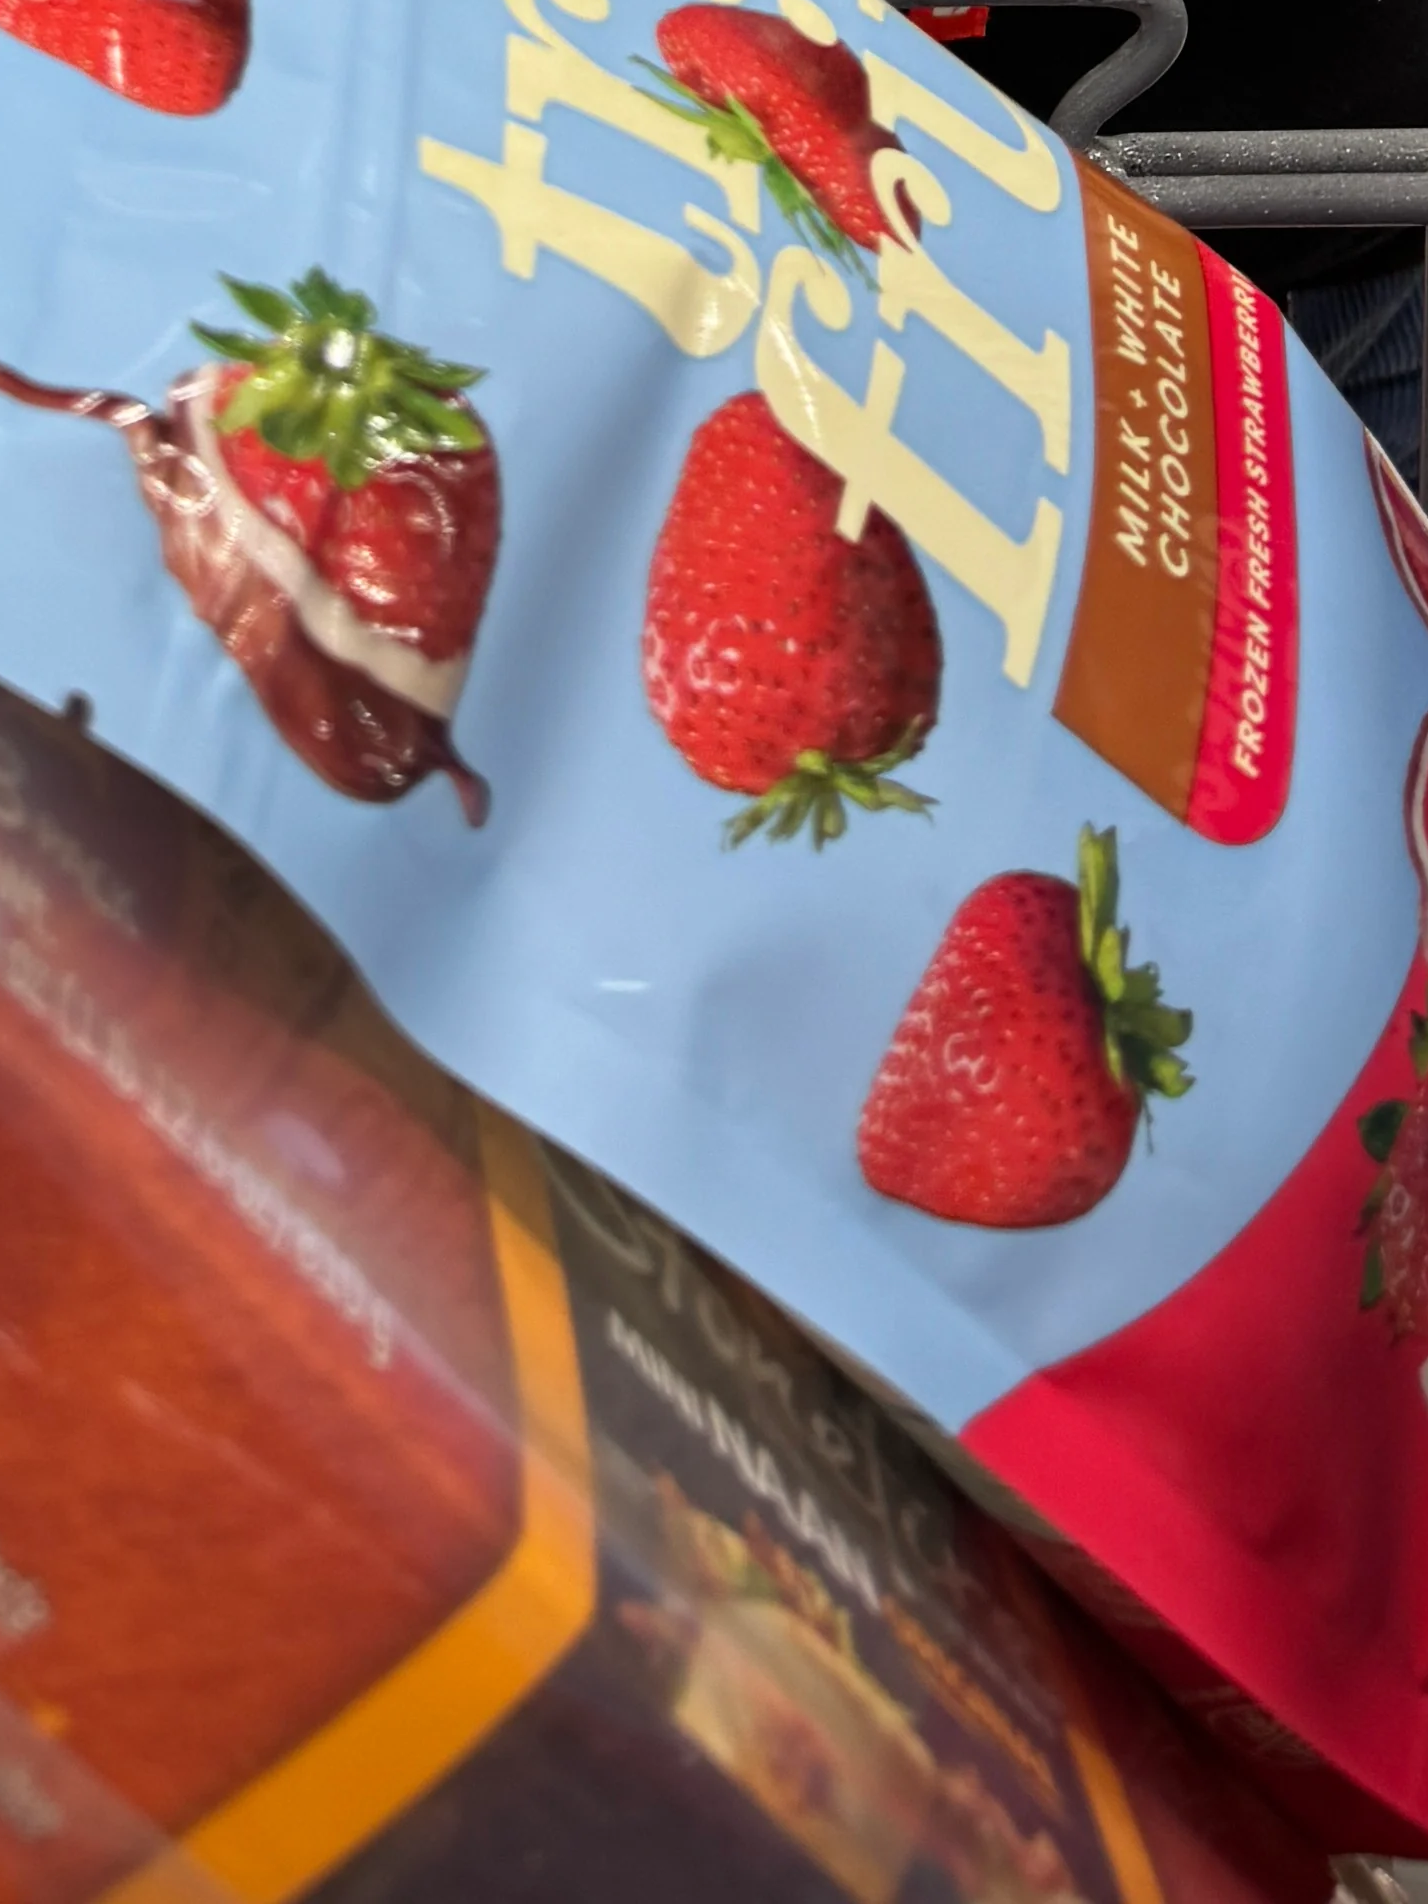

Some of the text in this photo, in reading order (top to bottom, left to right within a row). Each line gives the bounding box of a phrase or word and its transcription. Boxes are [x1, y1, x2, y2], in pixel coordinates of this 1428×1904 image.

[1107, 212, 1149, 367] WHITE
[1114, 416, 1152, 568] MILK
[1150, 259, 1191, 581] CHOCOLATE
[1245, 489, 1273, 612] FRESH
[1232, 612, 1273, 781] FROZEN
